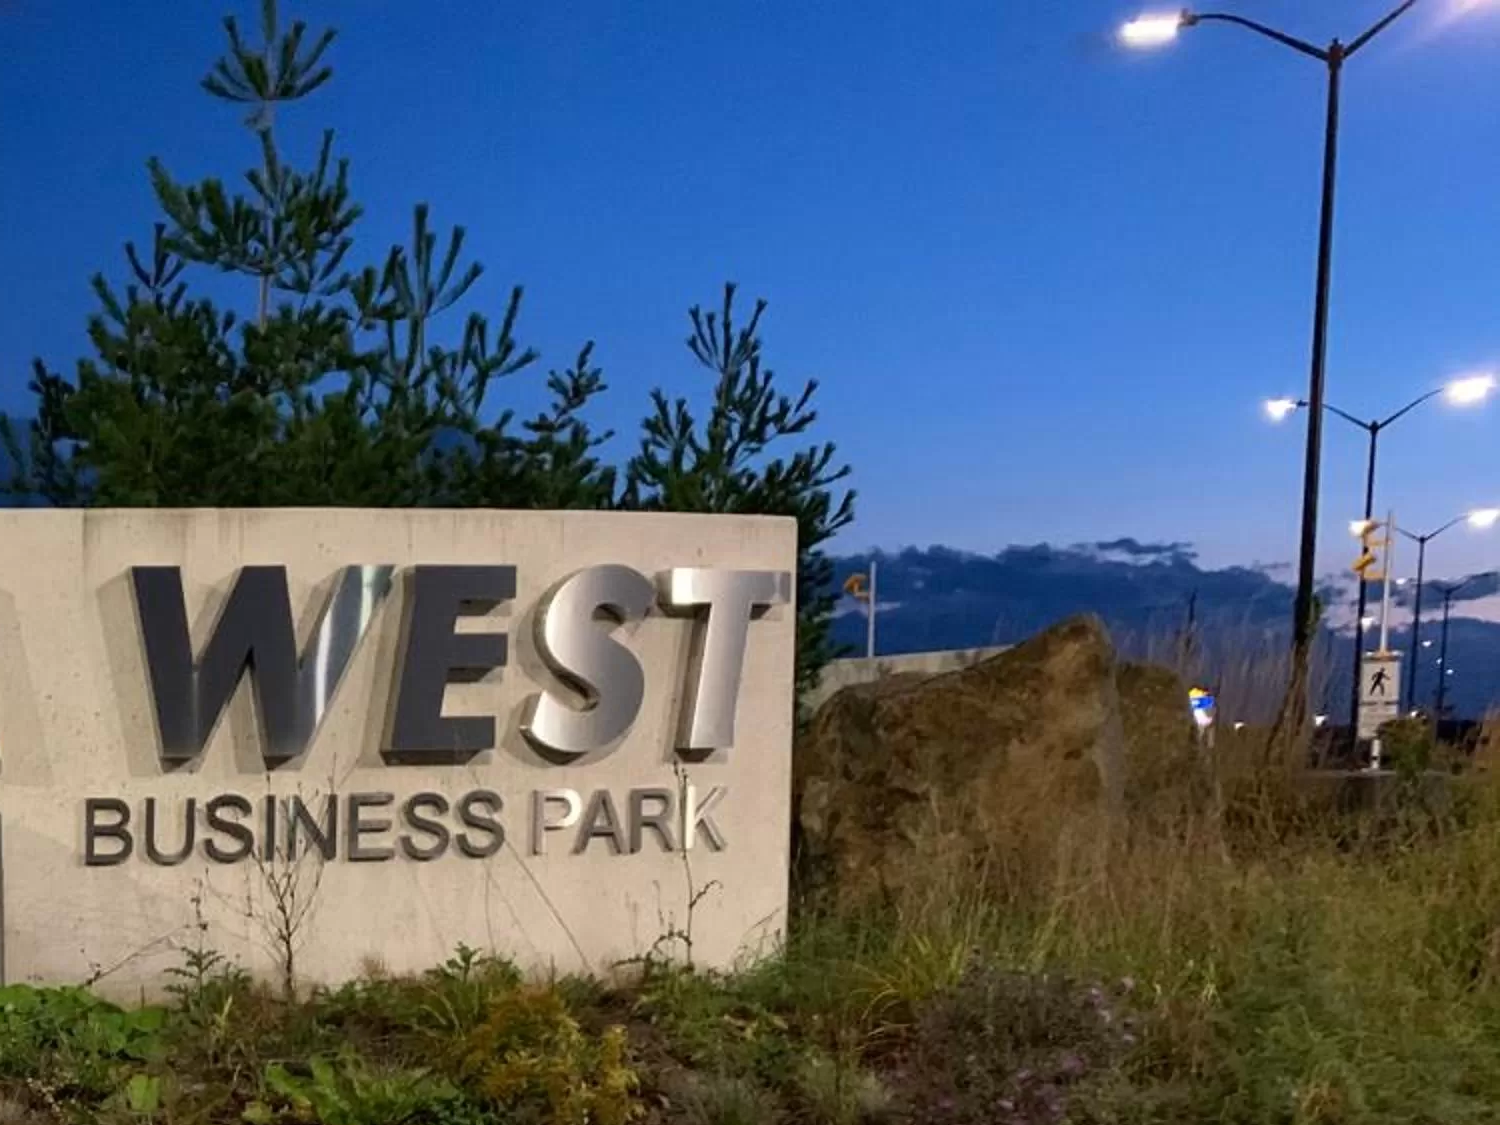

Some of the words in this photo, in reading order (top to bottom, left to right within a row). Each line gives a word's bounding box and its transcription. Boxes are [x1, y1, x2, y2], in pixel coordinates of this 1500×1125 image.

[130, 564, 792, 766] WEST
[84, 788, 507, 866] BUSINESS
[532, 786, 731, 858] PARK
